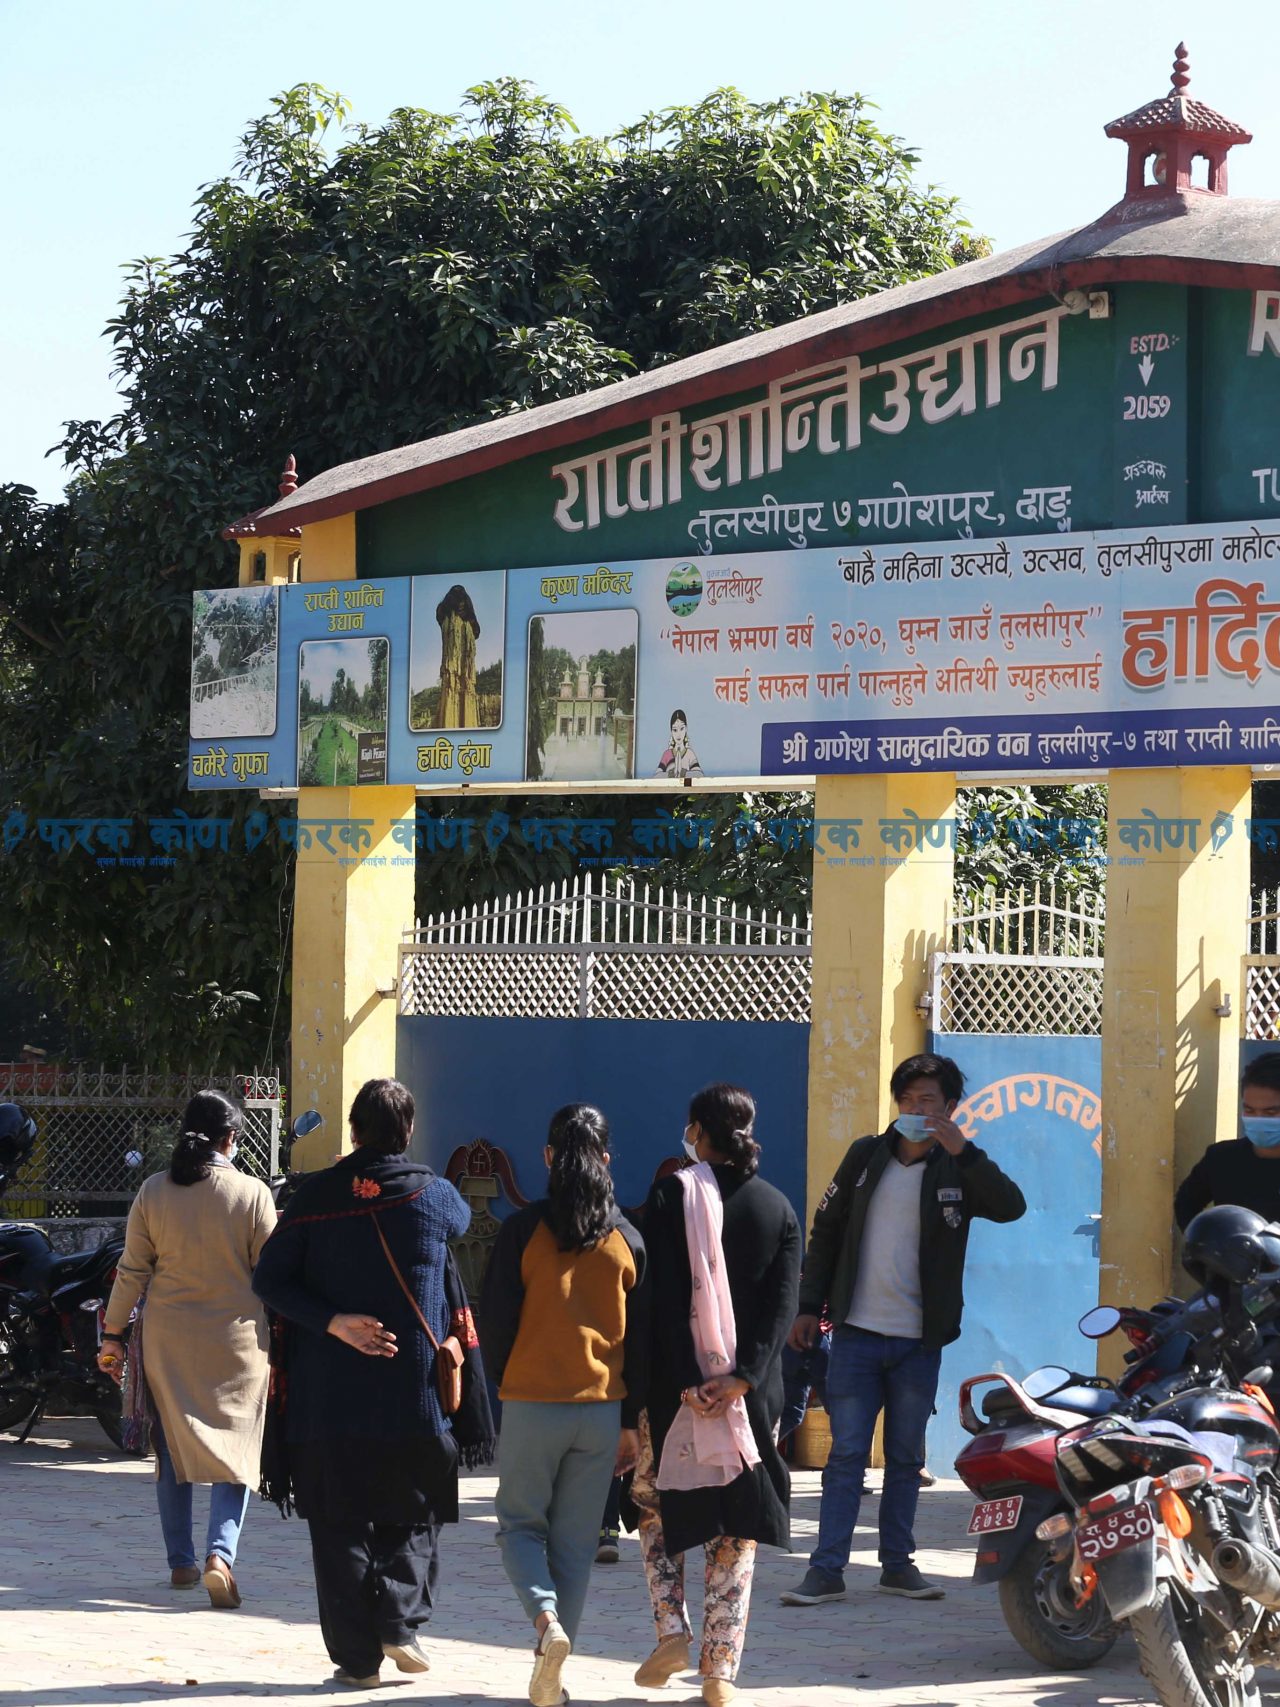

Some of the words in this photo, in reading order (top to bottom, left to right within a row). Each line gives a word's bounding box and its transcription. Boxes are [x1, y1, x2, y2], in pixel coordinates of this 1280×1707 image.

[552, 411, 692, 532] राप्ती
[690, 356, 872, 491] शान्ति
[868, 307, 1066, 433] उद्यान
[1123, 396, 1171, 420] 2059
[687, 493, 829, 556] तुलसीपुर
[832, 500, 852, 526] ७
[882, 551, 944, 584] महिना
[1097, 536, 1215, 577] तुलसीपुरमा
[303, 588, 340, 612] राप्ती
[343, 584, 385, 608] शान्ति
[540, 575, 579, 603] कृष्ण
[582, 567, 633, 596] मन्दिर
[705, 570, 764, 606] तुलसीपुर
[327, 612, 365, 632] उद्यान
[728, 626, 779, 653] भ्रमण
[786, 615, 815, 650] वर्ष
[898, 617, 941, 655] घुम्न
[948, 603, 993, 642] जाउँ
[714, 669, 751, 705] लाई
[758, 674, 809, 702] सफल
[817, 664, 851, 699] पार्न
[935, 657, 999, 695] अतिथी
[782, 732, 808, 765] श्री
[814, 730, 871, 763] गणेश
[877, 726, 991, 767] सामुदायिक
[997, 732, 1032, 757] वन
[1144, 729, 1178, 752] तथा
[1184, 719, 1233, 752] राप्ती
[191, 746, 229, 778] चमेरे
[232, 751, 270, 783] गुफा
